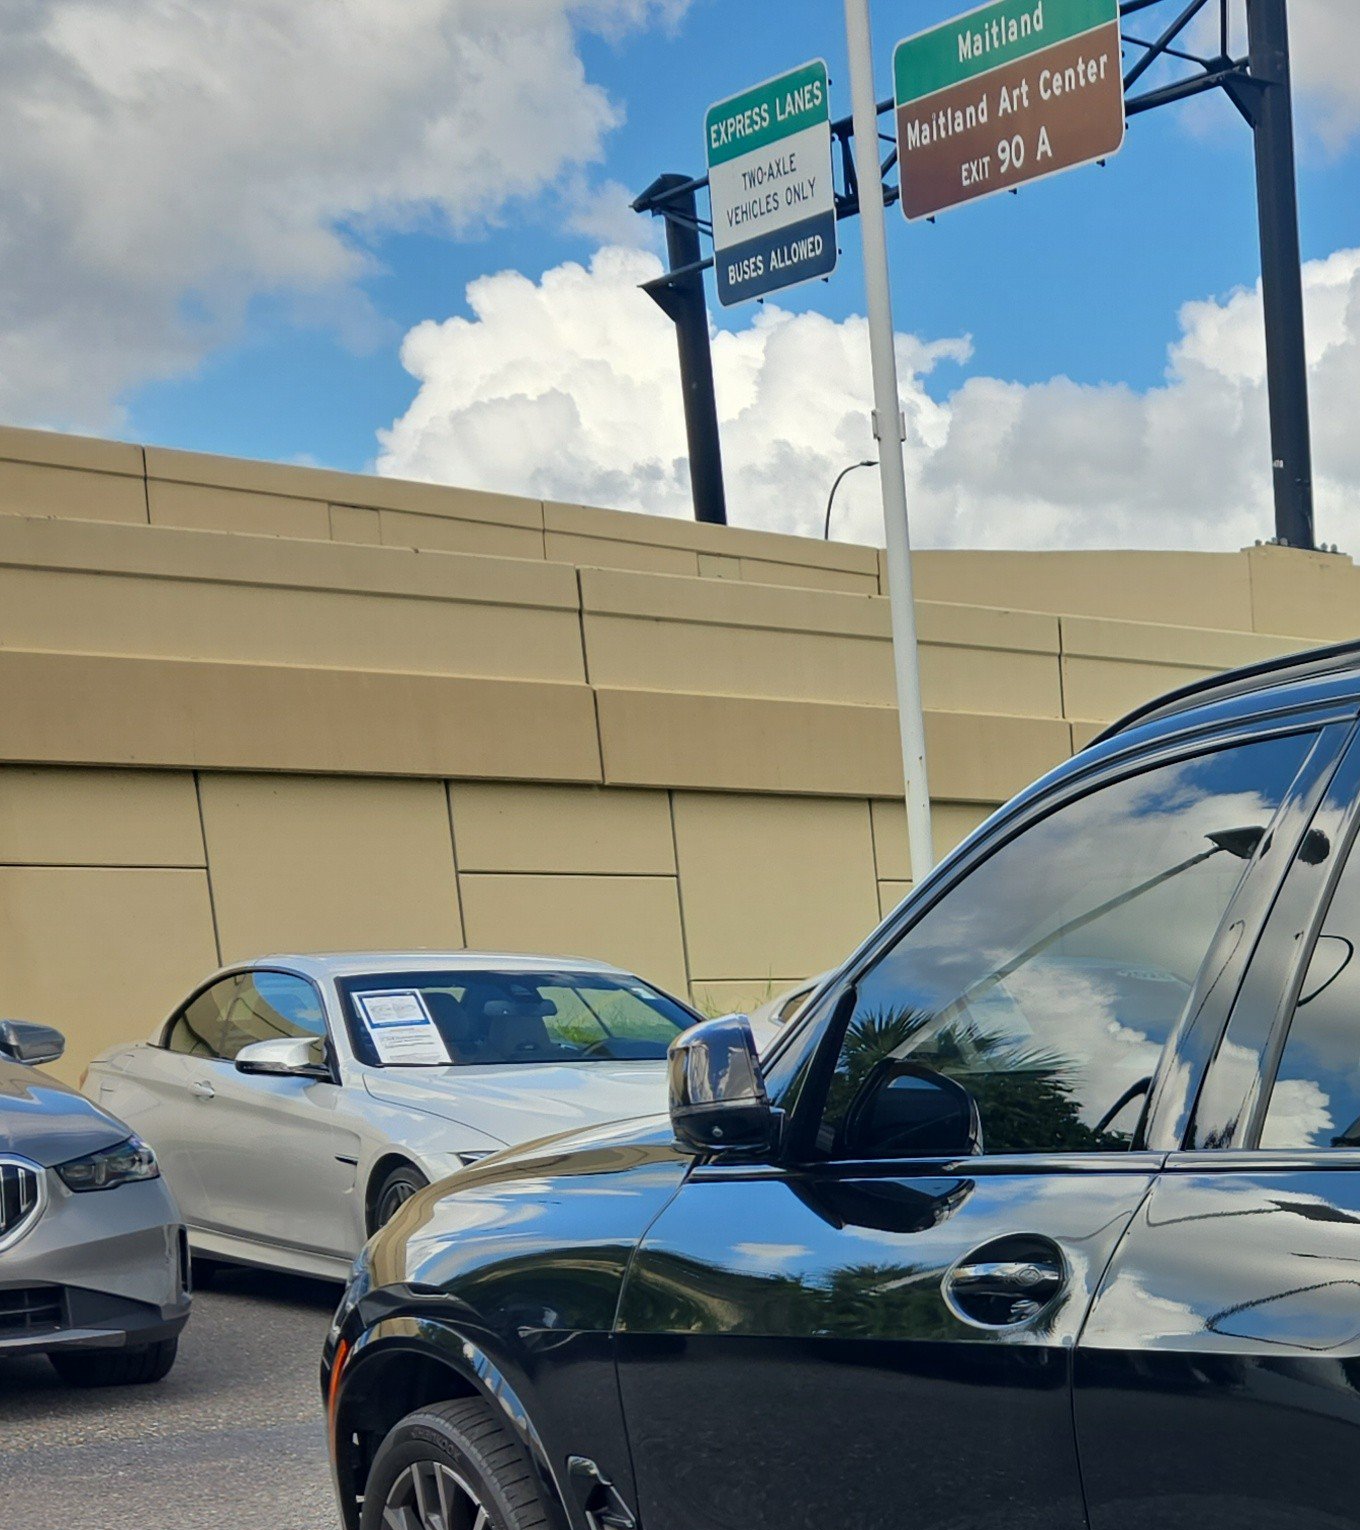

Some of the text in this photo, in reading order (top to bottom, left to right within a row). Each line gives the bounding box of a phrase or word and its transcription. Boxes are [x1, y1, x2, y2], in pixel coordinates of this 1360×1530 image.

[957, 1, 1043, 62] Maitland
[710, 80, 822, 149] EXPRESS LANES
[907, 53, 1107, 150] Maitland Art Center
[742, 153, 797, 191] TWO-AXLE
[961, 125, 1052, 186] EXIT 90 A
[727, 176, 816, 227] VEHICLES ONLY
[728, 235, 823, 285] BUSES ALLOWED
